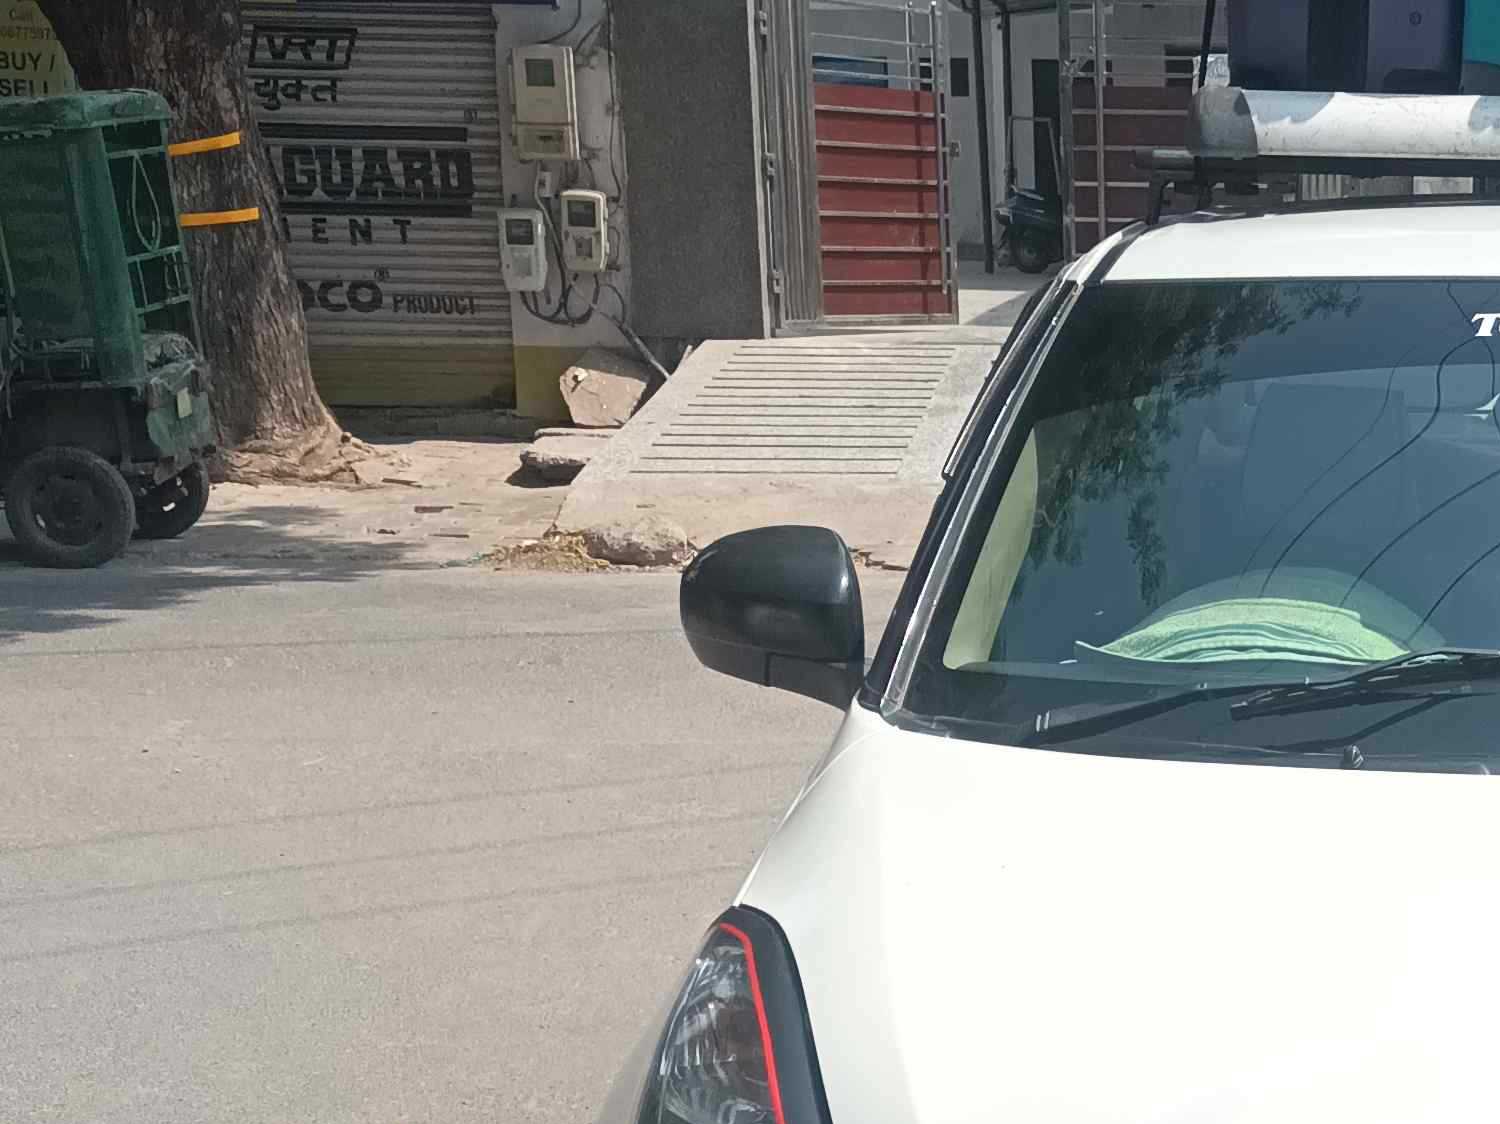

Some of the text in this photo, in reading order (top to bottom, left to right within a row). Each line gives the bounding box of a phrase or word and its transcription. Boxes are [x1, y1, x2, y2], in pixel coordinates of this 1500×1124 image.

[0, 51, 42, 72] BUY
[282, 146, 474, 200] GUARD
[282, 216, 413, 245] ENT
[392, 294, 477, 315] PRODUCT
